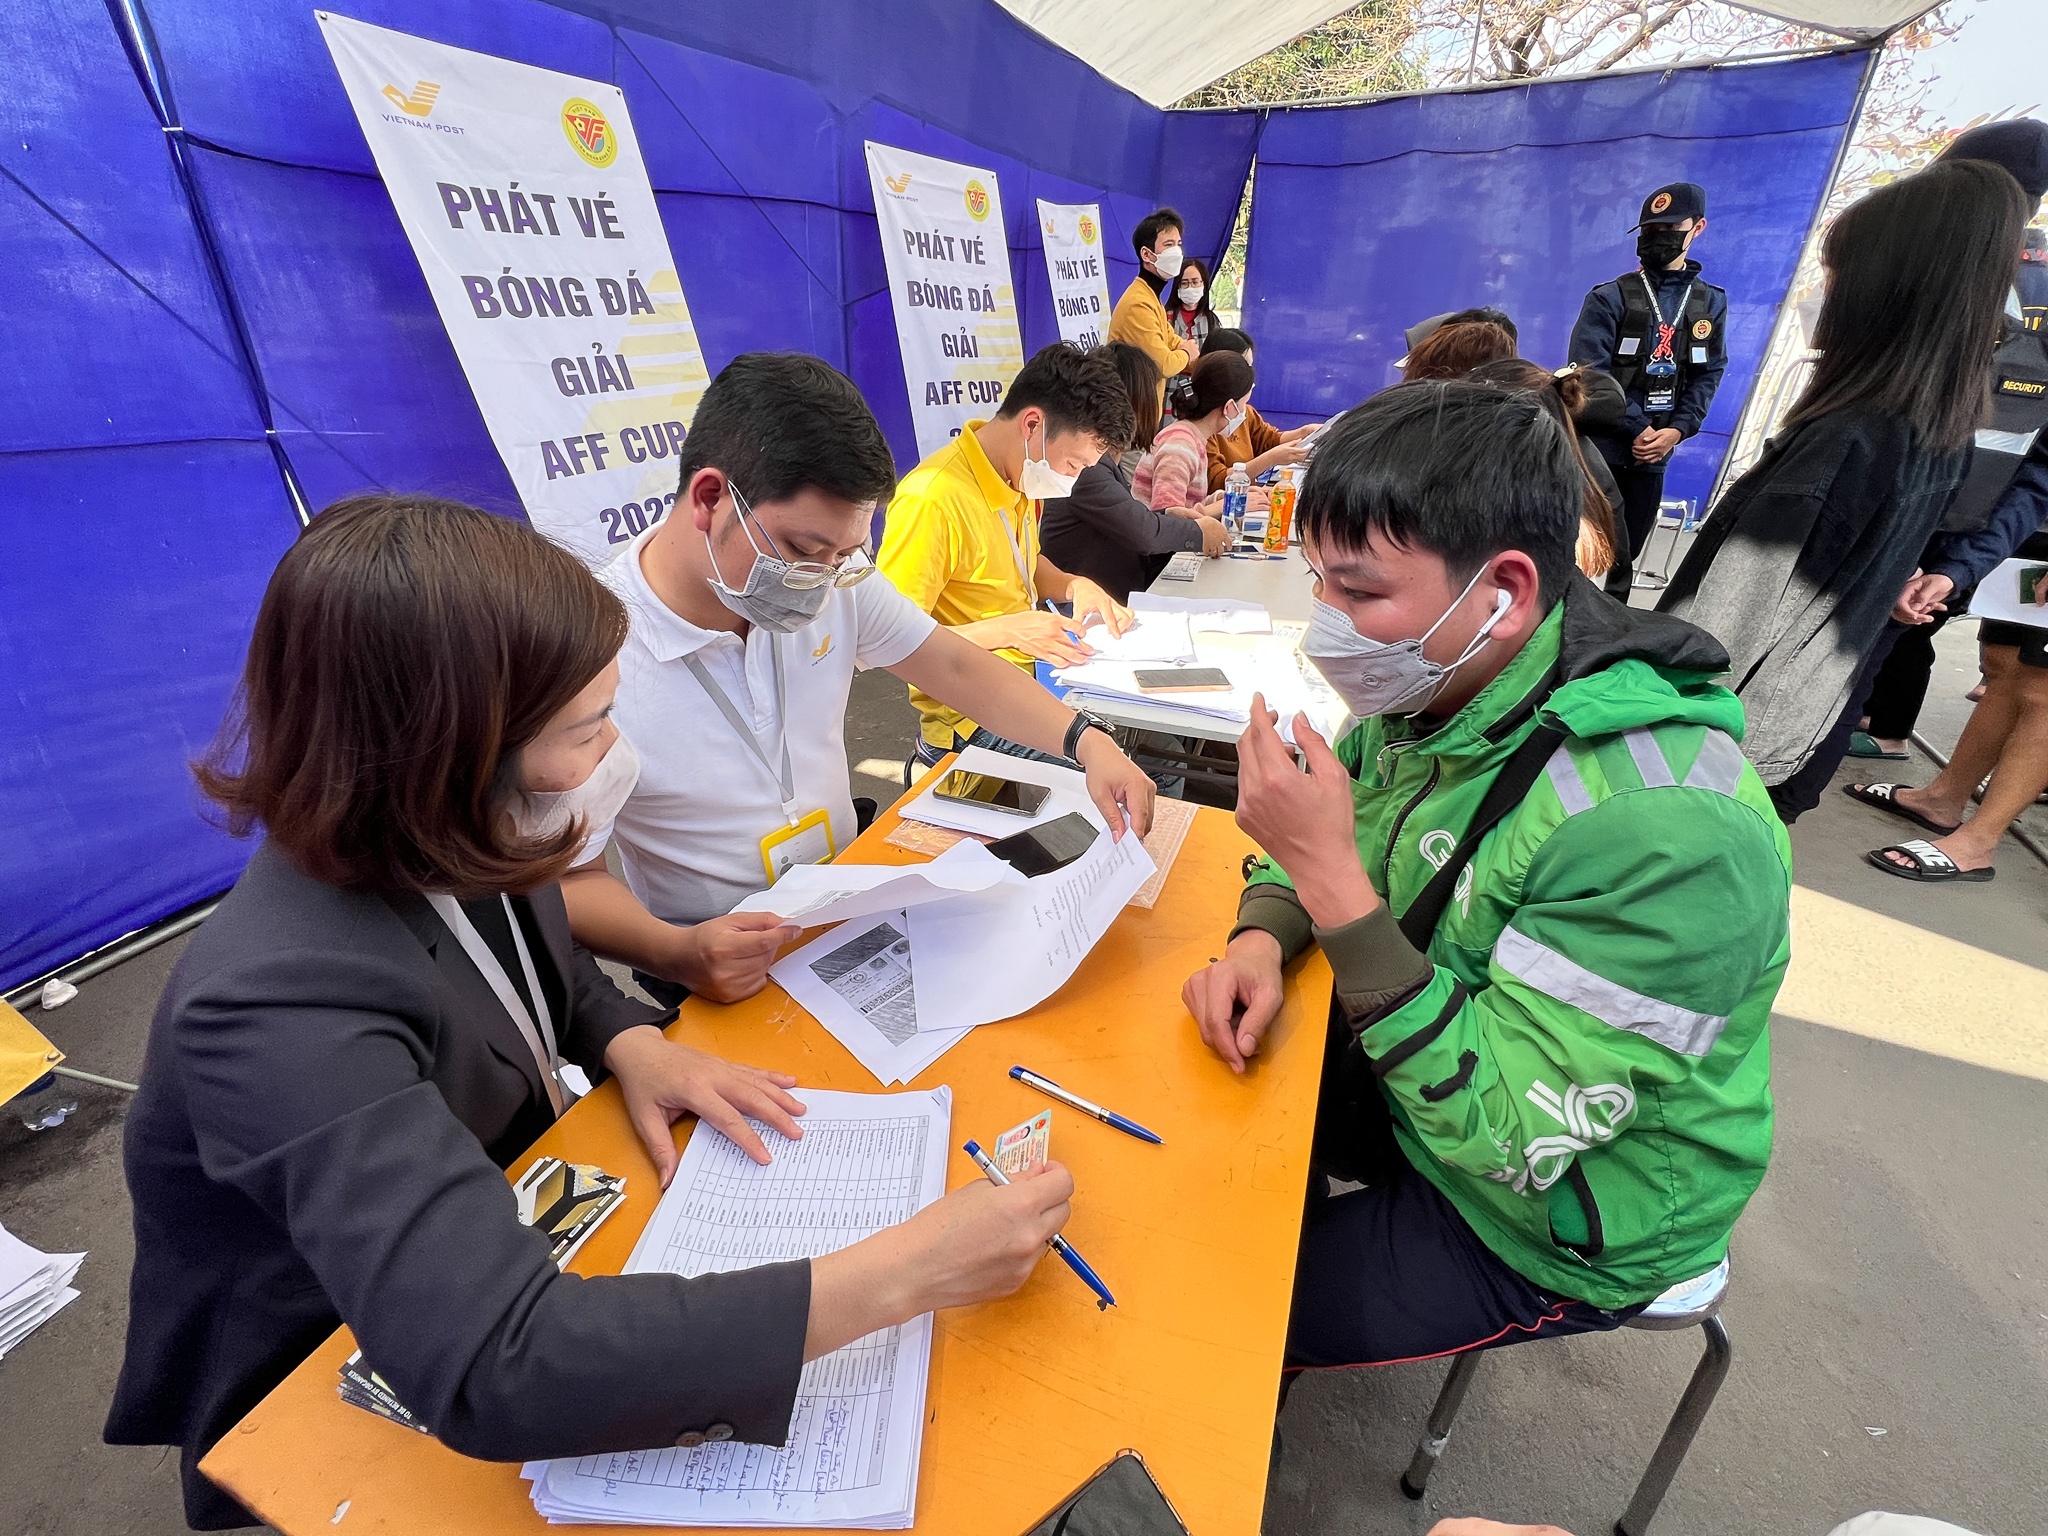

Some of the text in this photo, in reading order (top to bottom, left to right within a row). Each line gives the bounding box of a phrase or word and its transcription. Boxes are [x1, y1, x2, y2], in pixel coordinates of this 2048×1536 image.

[382, 113, 465, 135] VIETNAM POST
[436, 182, 625, 239] PHÁT VÉ
[903, 228, 986, 265] PHÁT VÉ
[1055, 255, 1099, 280] PHÁT VÉ
[461, 267, 656, 318] BÓNG ĐÁ
[907, 278, 996, 313] BÓNG ĐÁ
[1058, 294, 1089, 318] BÓNG
[941, 326, 979, 358] GIẢI
[551, 342, 635, 397] GIẢI
[925, 380, 1003, 406] AFF CUP
[2003, 381, 2046, 394] SECURITY
[540, 421, 687, 480] AFF CUP
